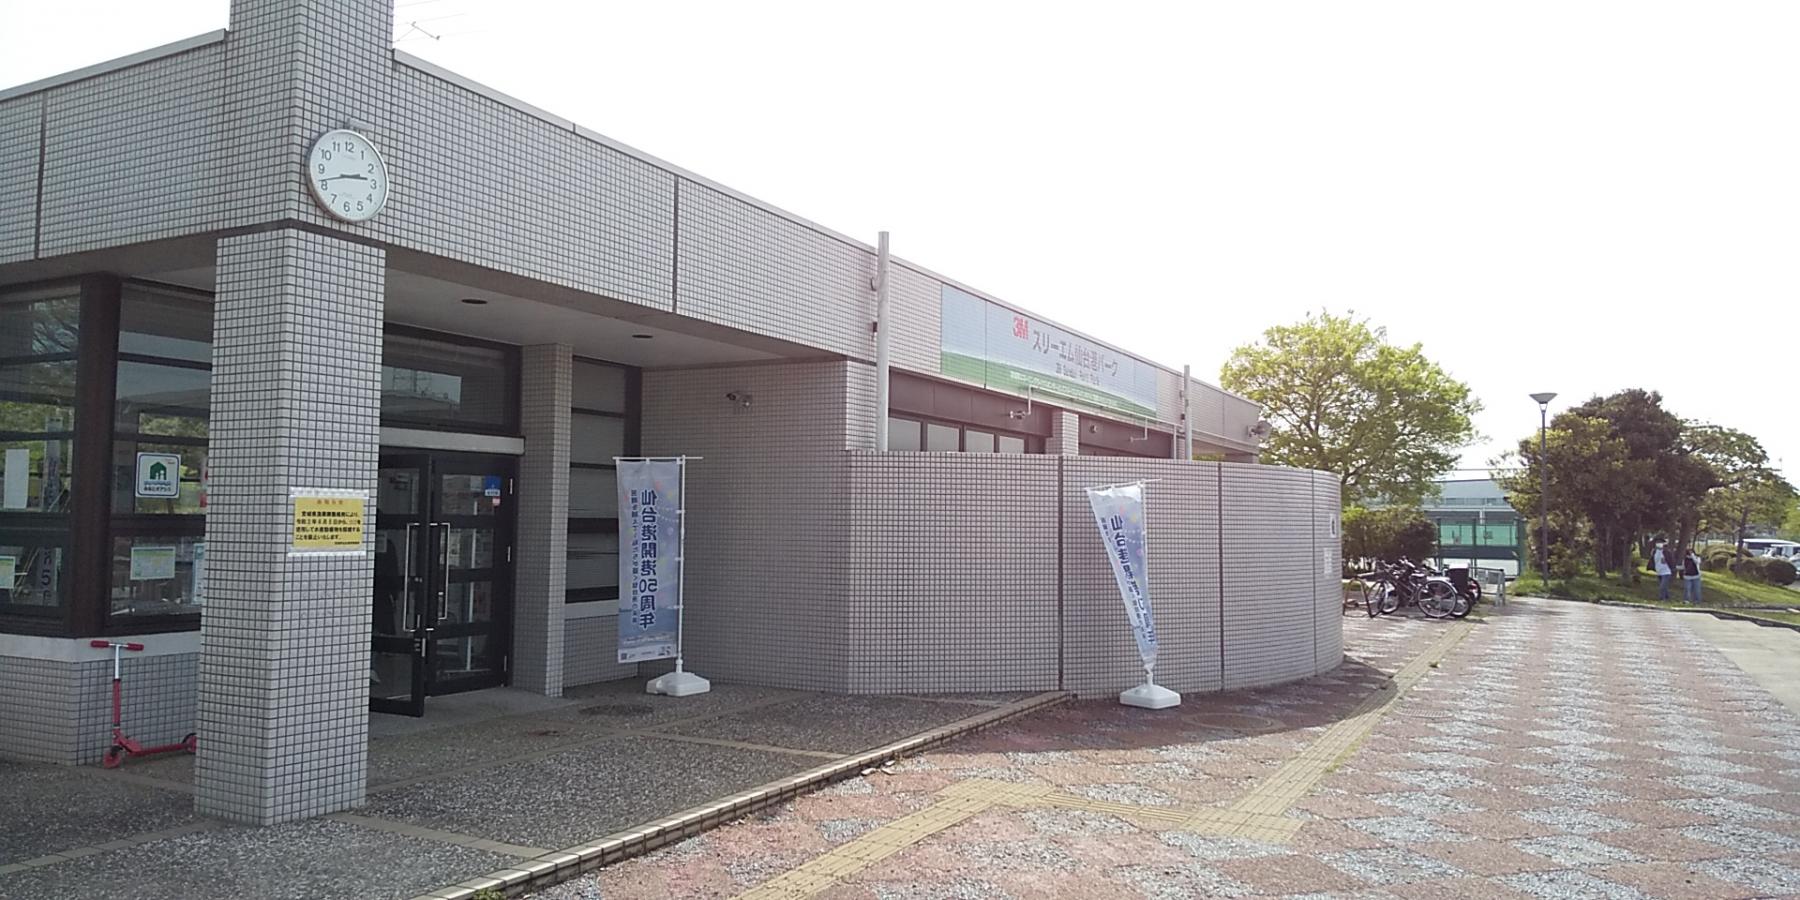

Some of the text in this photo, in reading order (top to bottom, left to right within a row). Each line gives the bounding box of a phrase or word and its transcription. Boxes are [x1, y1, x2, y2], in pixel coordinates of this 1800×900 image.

[333, 141, 340, 152] 11
[345, 141, 354, 153] 12
[321, 149, 331, 160] 10
[361, 150, 364, 160] 1
[318, 164, 325, 174] 9
[368, 163, 374, 173] 2
[321, 181, 328, 190] 8
[370, 179, 377, 189] 3
[330, 193, 337, 204] 7
[366, 193, 373, 203] 4
[344, 201, 350, 212] 6
[357, 201, 364, 211] 5
[1013, 316, 1028, 340] 3M
